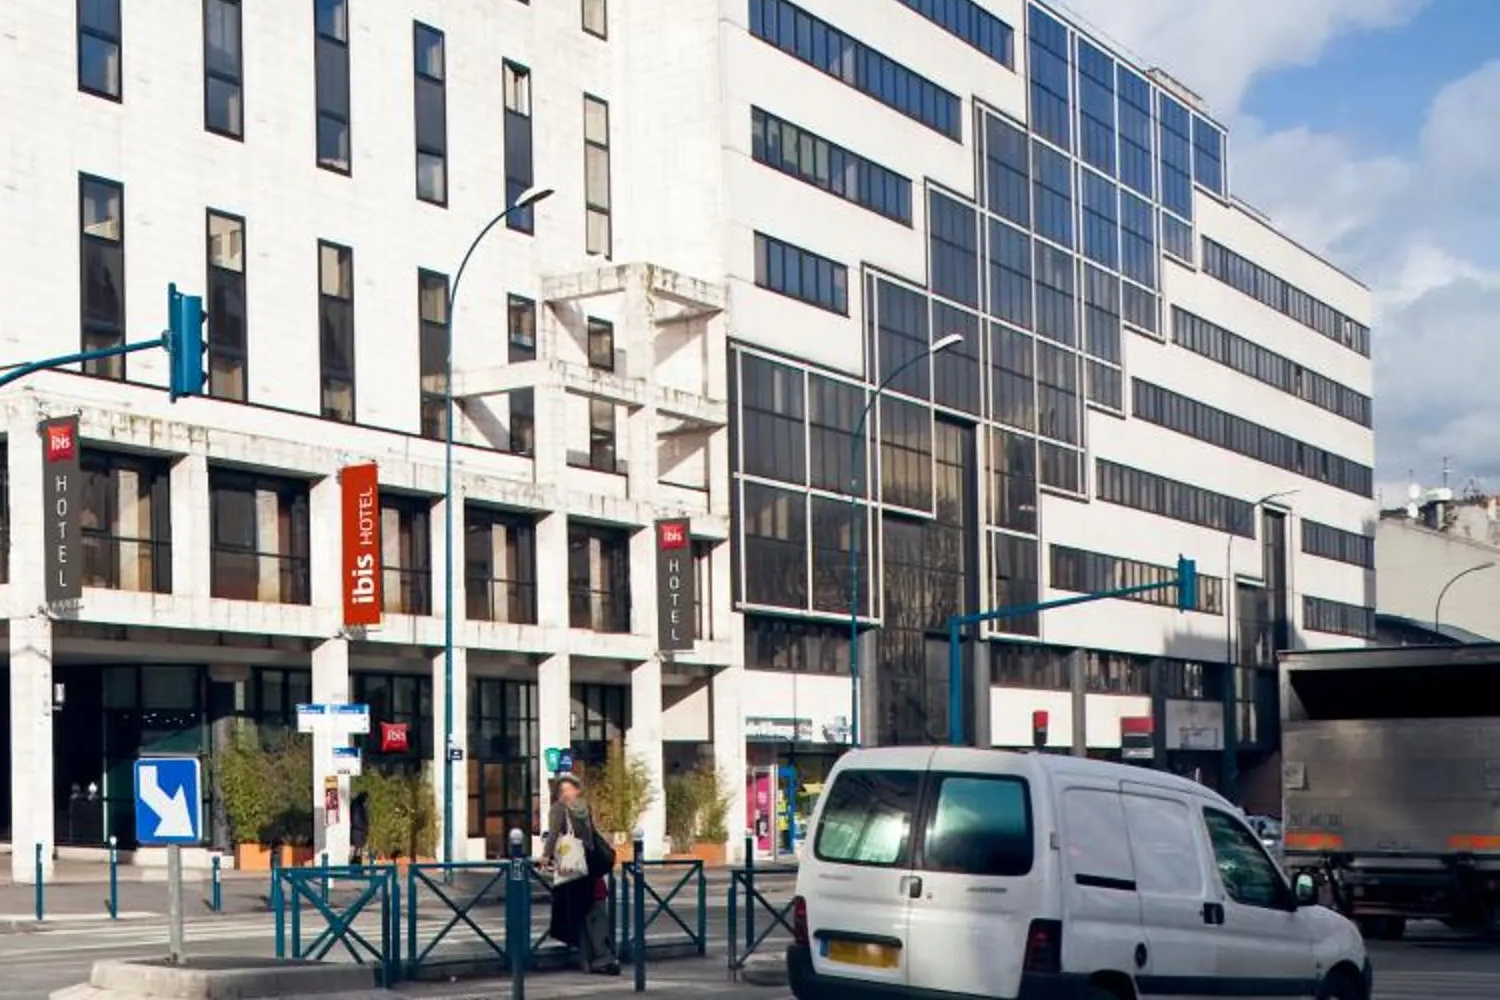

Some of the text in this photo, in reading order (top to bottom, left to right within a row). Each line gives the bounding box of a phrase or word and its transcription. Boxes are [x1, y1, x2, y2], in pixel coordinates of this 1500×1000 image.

[51, 435, 71, 450] ibis
[55, 475, 68, 588] HOTEL
[352, 487, 375, 604] ibis HOTEL
[669, 559, 680, 641] HOTEL
